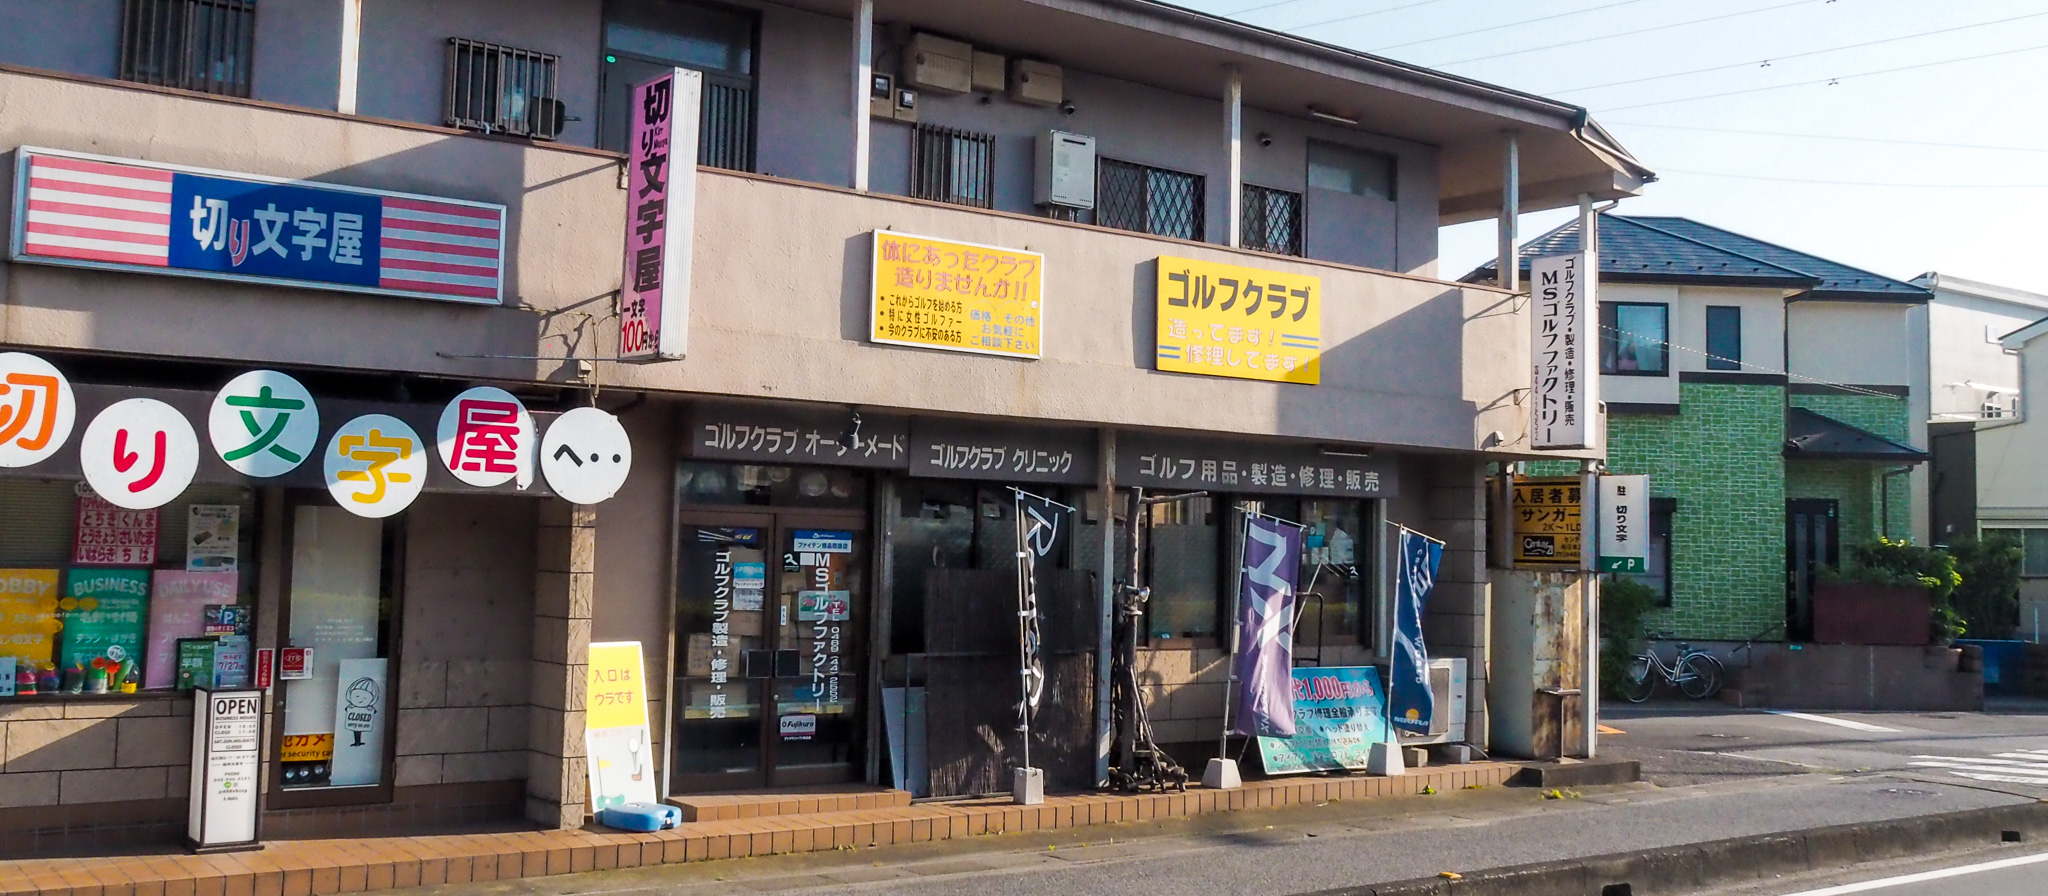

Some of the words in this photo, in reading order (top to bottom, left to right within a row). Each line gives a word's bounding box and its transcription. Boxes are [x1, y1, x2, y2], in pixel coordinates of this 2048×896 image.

[632, 78, 671, 294] 切り文字屋
[189, 194, 364, 267] 切り文字屋
[882, 239, 1037, 279] 体にあったクラブ
[894, 266, 1028, 302] 造りませんか!!
[889, 294, 963, 314] これからゴルフを始める方
[1168, 269, 1311, 322] ゴルフクラブ
[623, 298, 646, 319] 一文字
[888, 308, 962, 328] 特に女性ゴルファー
[888, 323, 962, 344] 今のクラブに不安のある方
[981, 324, 1024, 338] お気軽に
[1168, 318, 1275, 346] 造ってます!
[970, 335, 1035, 350] ご相談下さい
[1186, 343, 1309, 373] 修理してます!
[1541, 270, 1560, 443] MSゴルフファクトリー
[705, 422, 799, 455] ゴルフクラブ
[805, 429, 906, 460] オーメード
[930, 443, 1006, 470] ゴルフクラブ
[1012, 449, 1073, 474] クリニック
[1139, 453, 1380, 492] ゴルフ用品・製造・修理・販売
[1627, 559, 1635, 570] P
[72, 577, 148, 597] BUSINESS
[159, 579, 200, 598] DAILY
[203, 580, 232, 598] USE
[812, 552, 831, 712] MSゴルフファクトリー
[593, 668, 631, 683] 入口は
[216, 699, 257, 715] OPEN
[594, 691, 634, 706] ウラです
[347, 712, 372, 722] CLOSED
[288, 749, 320, 759] security
